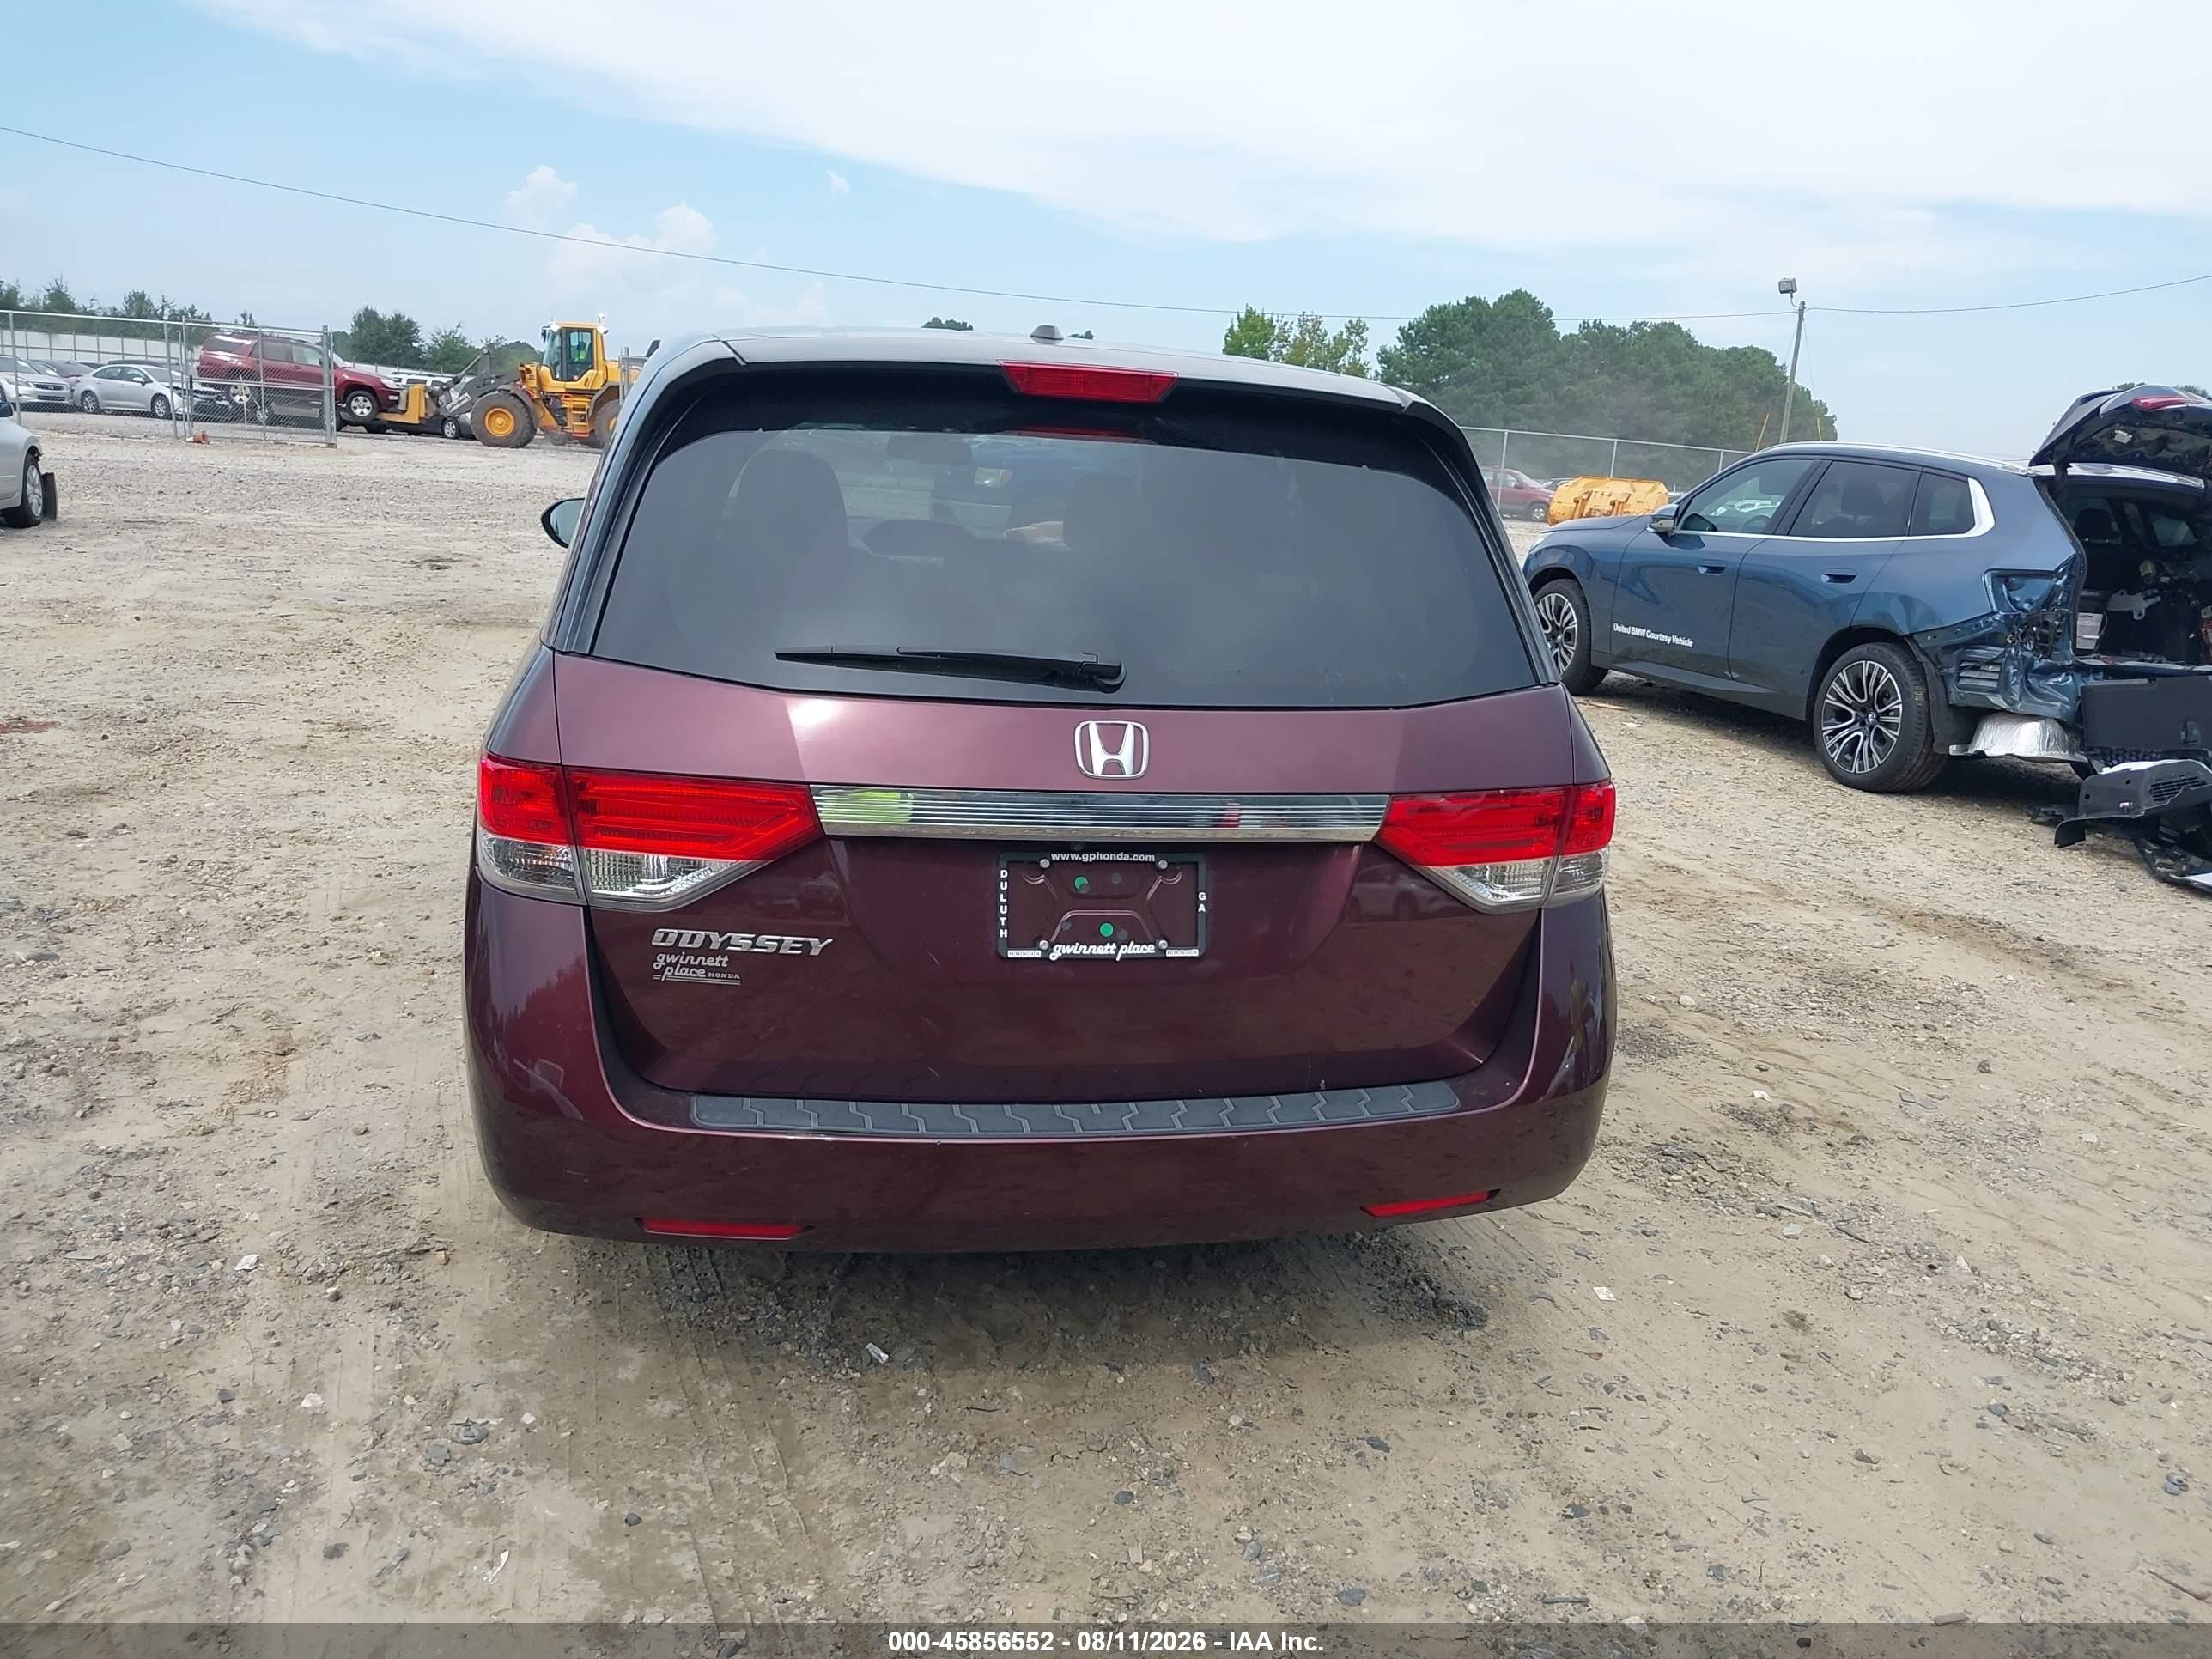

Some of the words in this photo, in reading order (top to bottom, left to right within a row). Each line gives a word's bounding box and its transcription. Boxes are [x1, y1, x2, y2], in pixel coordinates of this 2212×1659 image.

[1613, 623, 1632, 635] United
[1632, 626, 1646, 638] BMW
[1646, 629, 1672, 645] Courtesy
[1672, 635, 1694, 647] Vehicle
[1050, 851, 1156, 863] www.gphonda.com
[999, 869, 1009, 939] DULUTH
[651, 927, 834, 957] ODYSSEY
[1048, 941, 1117, 961] gwinnett
[1115, 941, 1156, 962] place
[653, 951, 729, 970] gwinnett
[661, 963, 707, 982] place
[708, 971, 742, 980] HONDA
